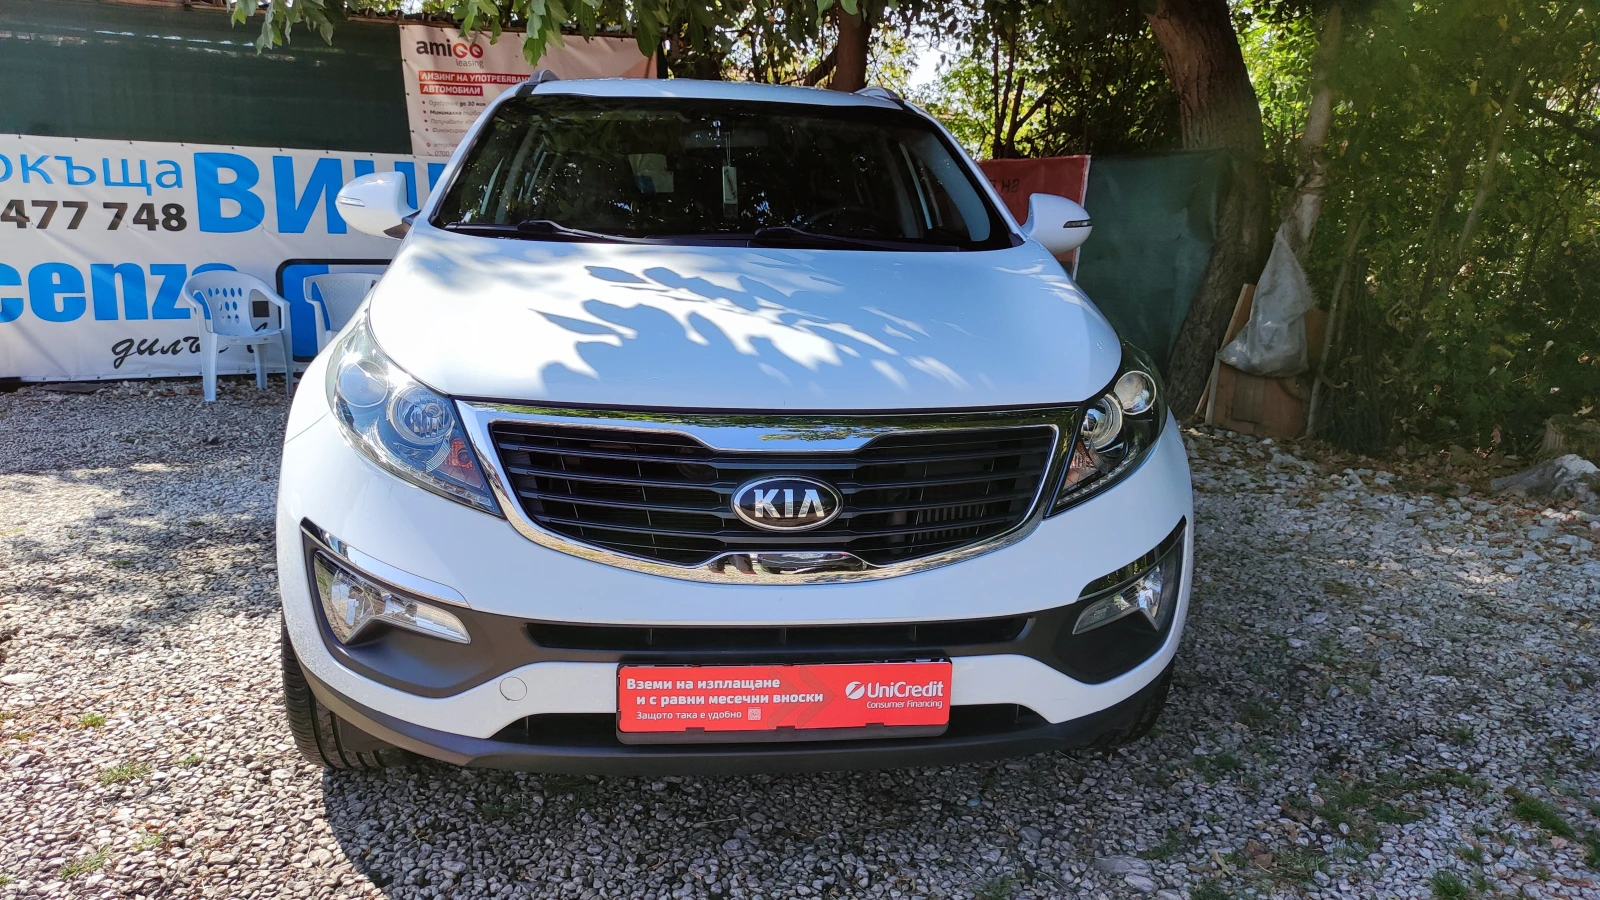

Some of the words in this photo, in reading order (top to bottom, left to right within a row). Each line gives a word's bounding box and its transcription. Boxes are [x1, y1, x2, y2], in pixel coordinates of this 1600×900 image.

[456, 60, 484, 69] leasing
[421, 72, 455, 80] ЛИЗИНГ
[456, 73, 468, 82] НА
[422, 85, 481, 94] АВТОМОБИЛИ
[0, 199, 89, 230] 477
[103, 202, 188, 231] 748
[753, 488, 825, 518] KIA
[626, 678, 673, 690] Вземи
[676, 681, 694, 689] на
[697, 678, 780, 690] изплащане
[867, 681, 944, 698] UniCredit
[636, 696, 646, 705] и
[649, 695, 657, 705] с
[660, 695, 705, 708] равни
[708, 693, 769, 705] месечни
[772, 693, 824, 703] вноски
[866, 701, 905, 709] Consumer
[906, 700, 943, 710] Financing
[636, 711, 673, 721] Защото
[708, 711, 742, 720] удобно
